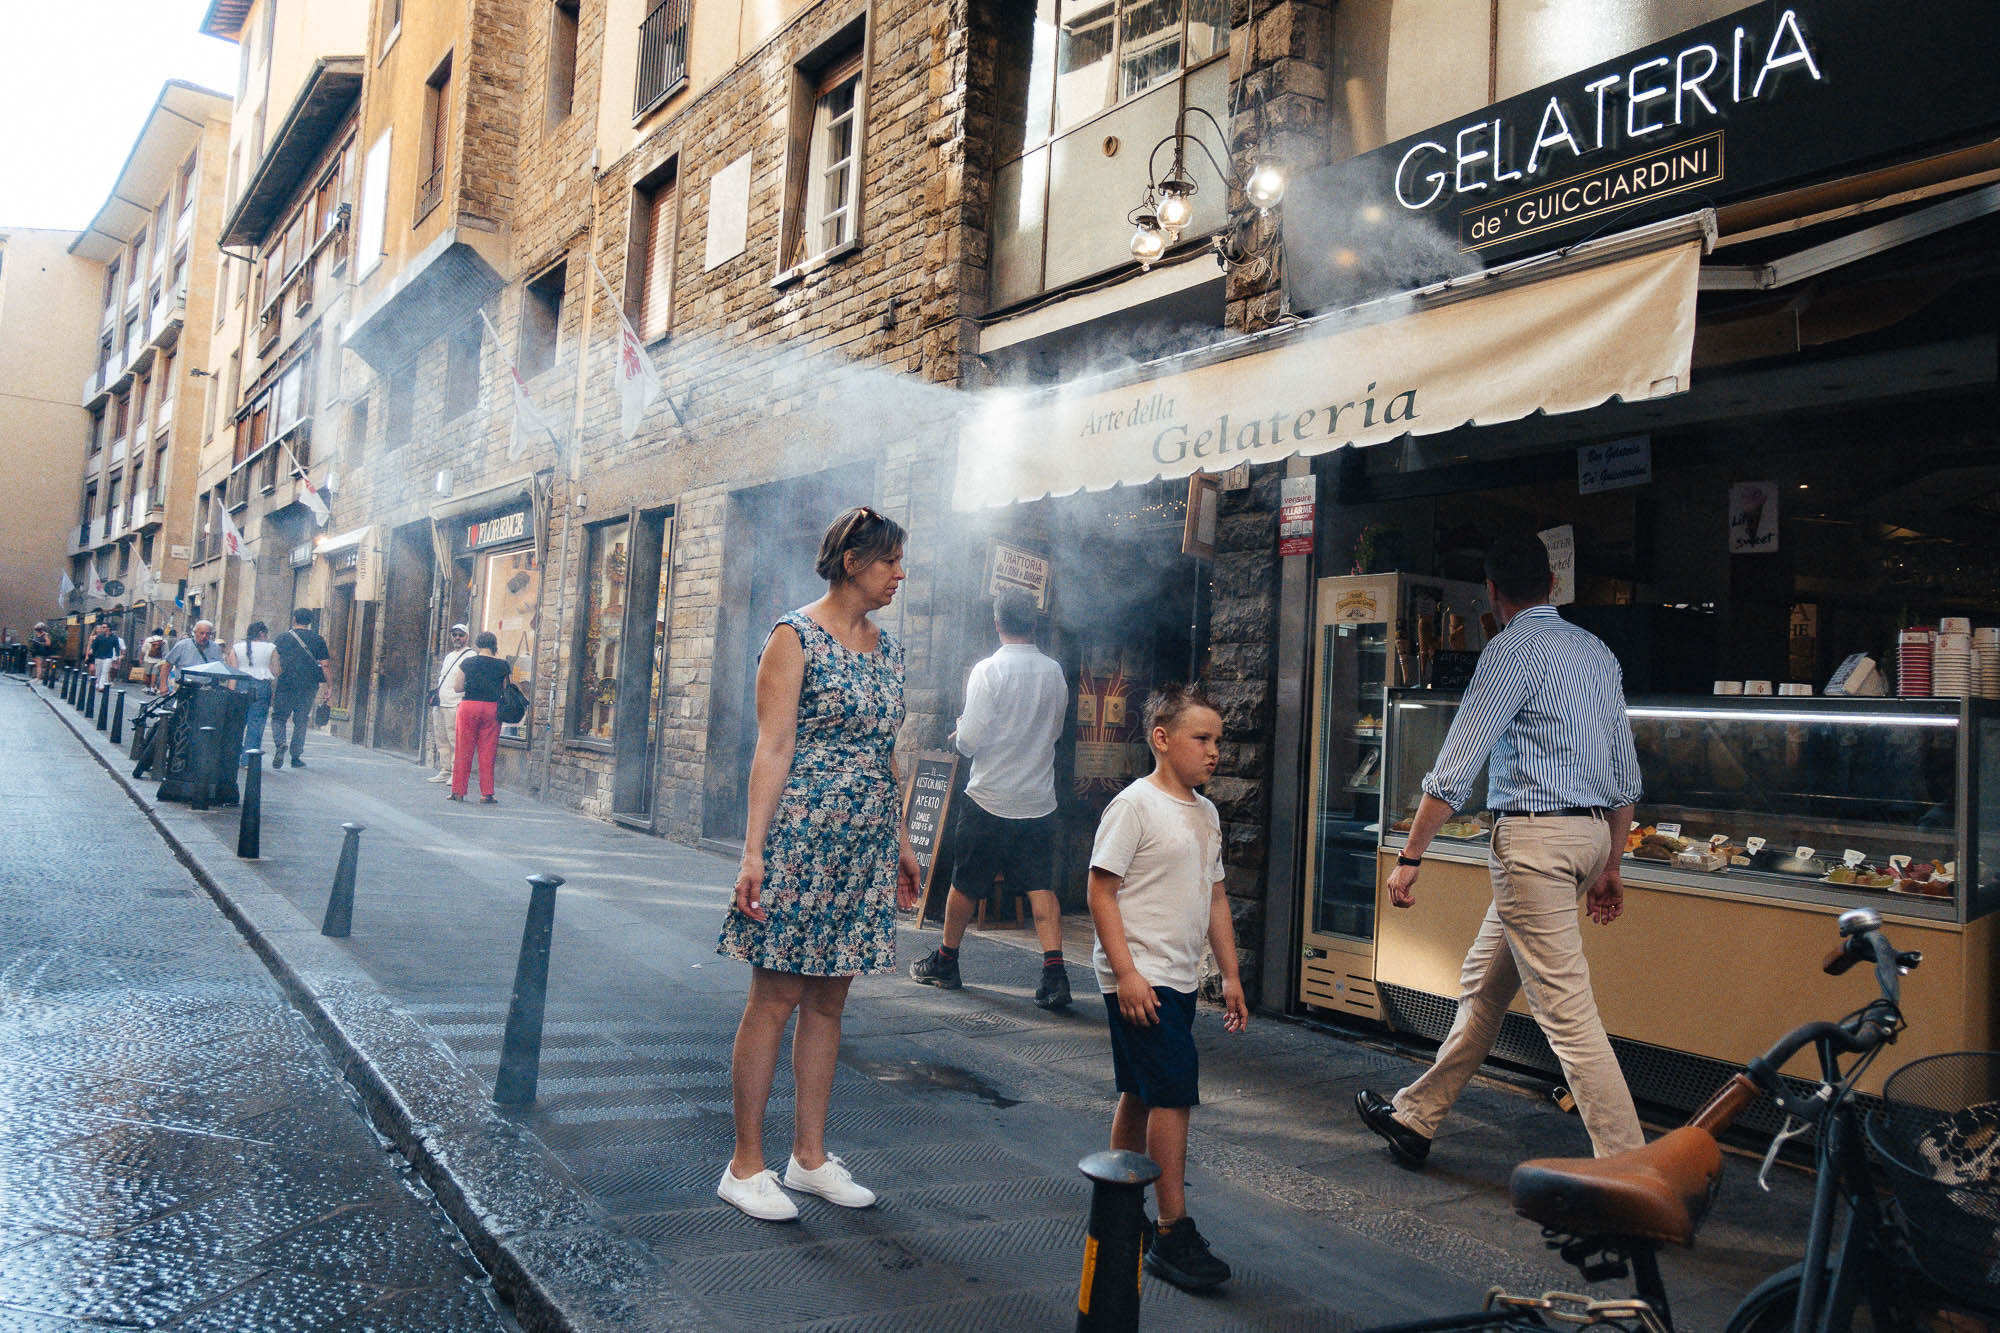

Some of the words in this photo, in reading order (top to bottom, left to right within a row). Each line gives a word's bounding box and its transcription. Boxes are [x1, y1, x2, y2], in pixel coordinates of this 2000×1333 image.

[1394, 9, 1821, 210] GELATERIA
[1471, 208, 1509, 240] de'
[1516, 147, 1708, 226] GUICCIARDINI
[1079, 406, 1124, 438] Arte
[1126, 393, 1176, 429] della
[1152, 380, 1421, 465] Gelateria
[1282, 504, 1313, 516] ALLARME
[478, 511, 525, 545] FLORENCE
[1003, 551, 1042, 573] TRATTORIA
[916, 776, 948, 792] RISTORANTE
[915, 795, 940, 809] APERTO
